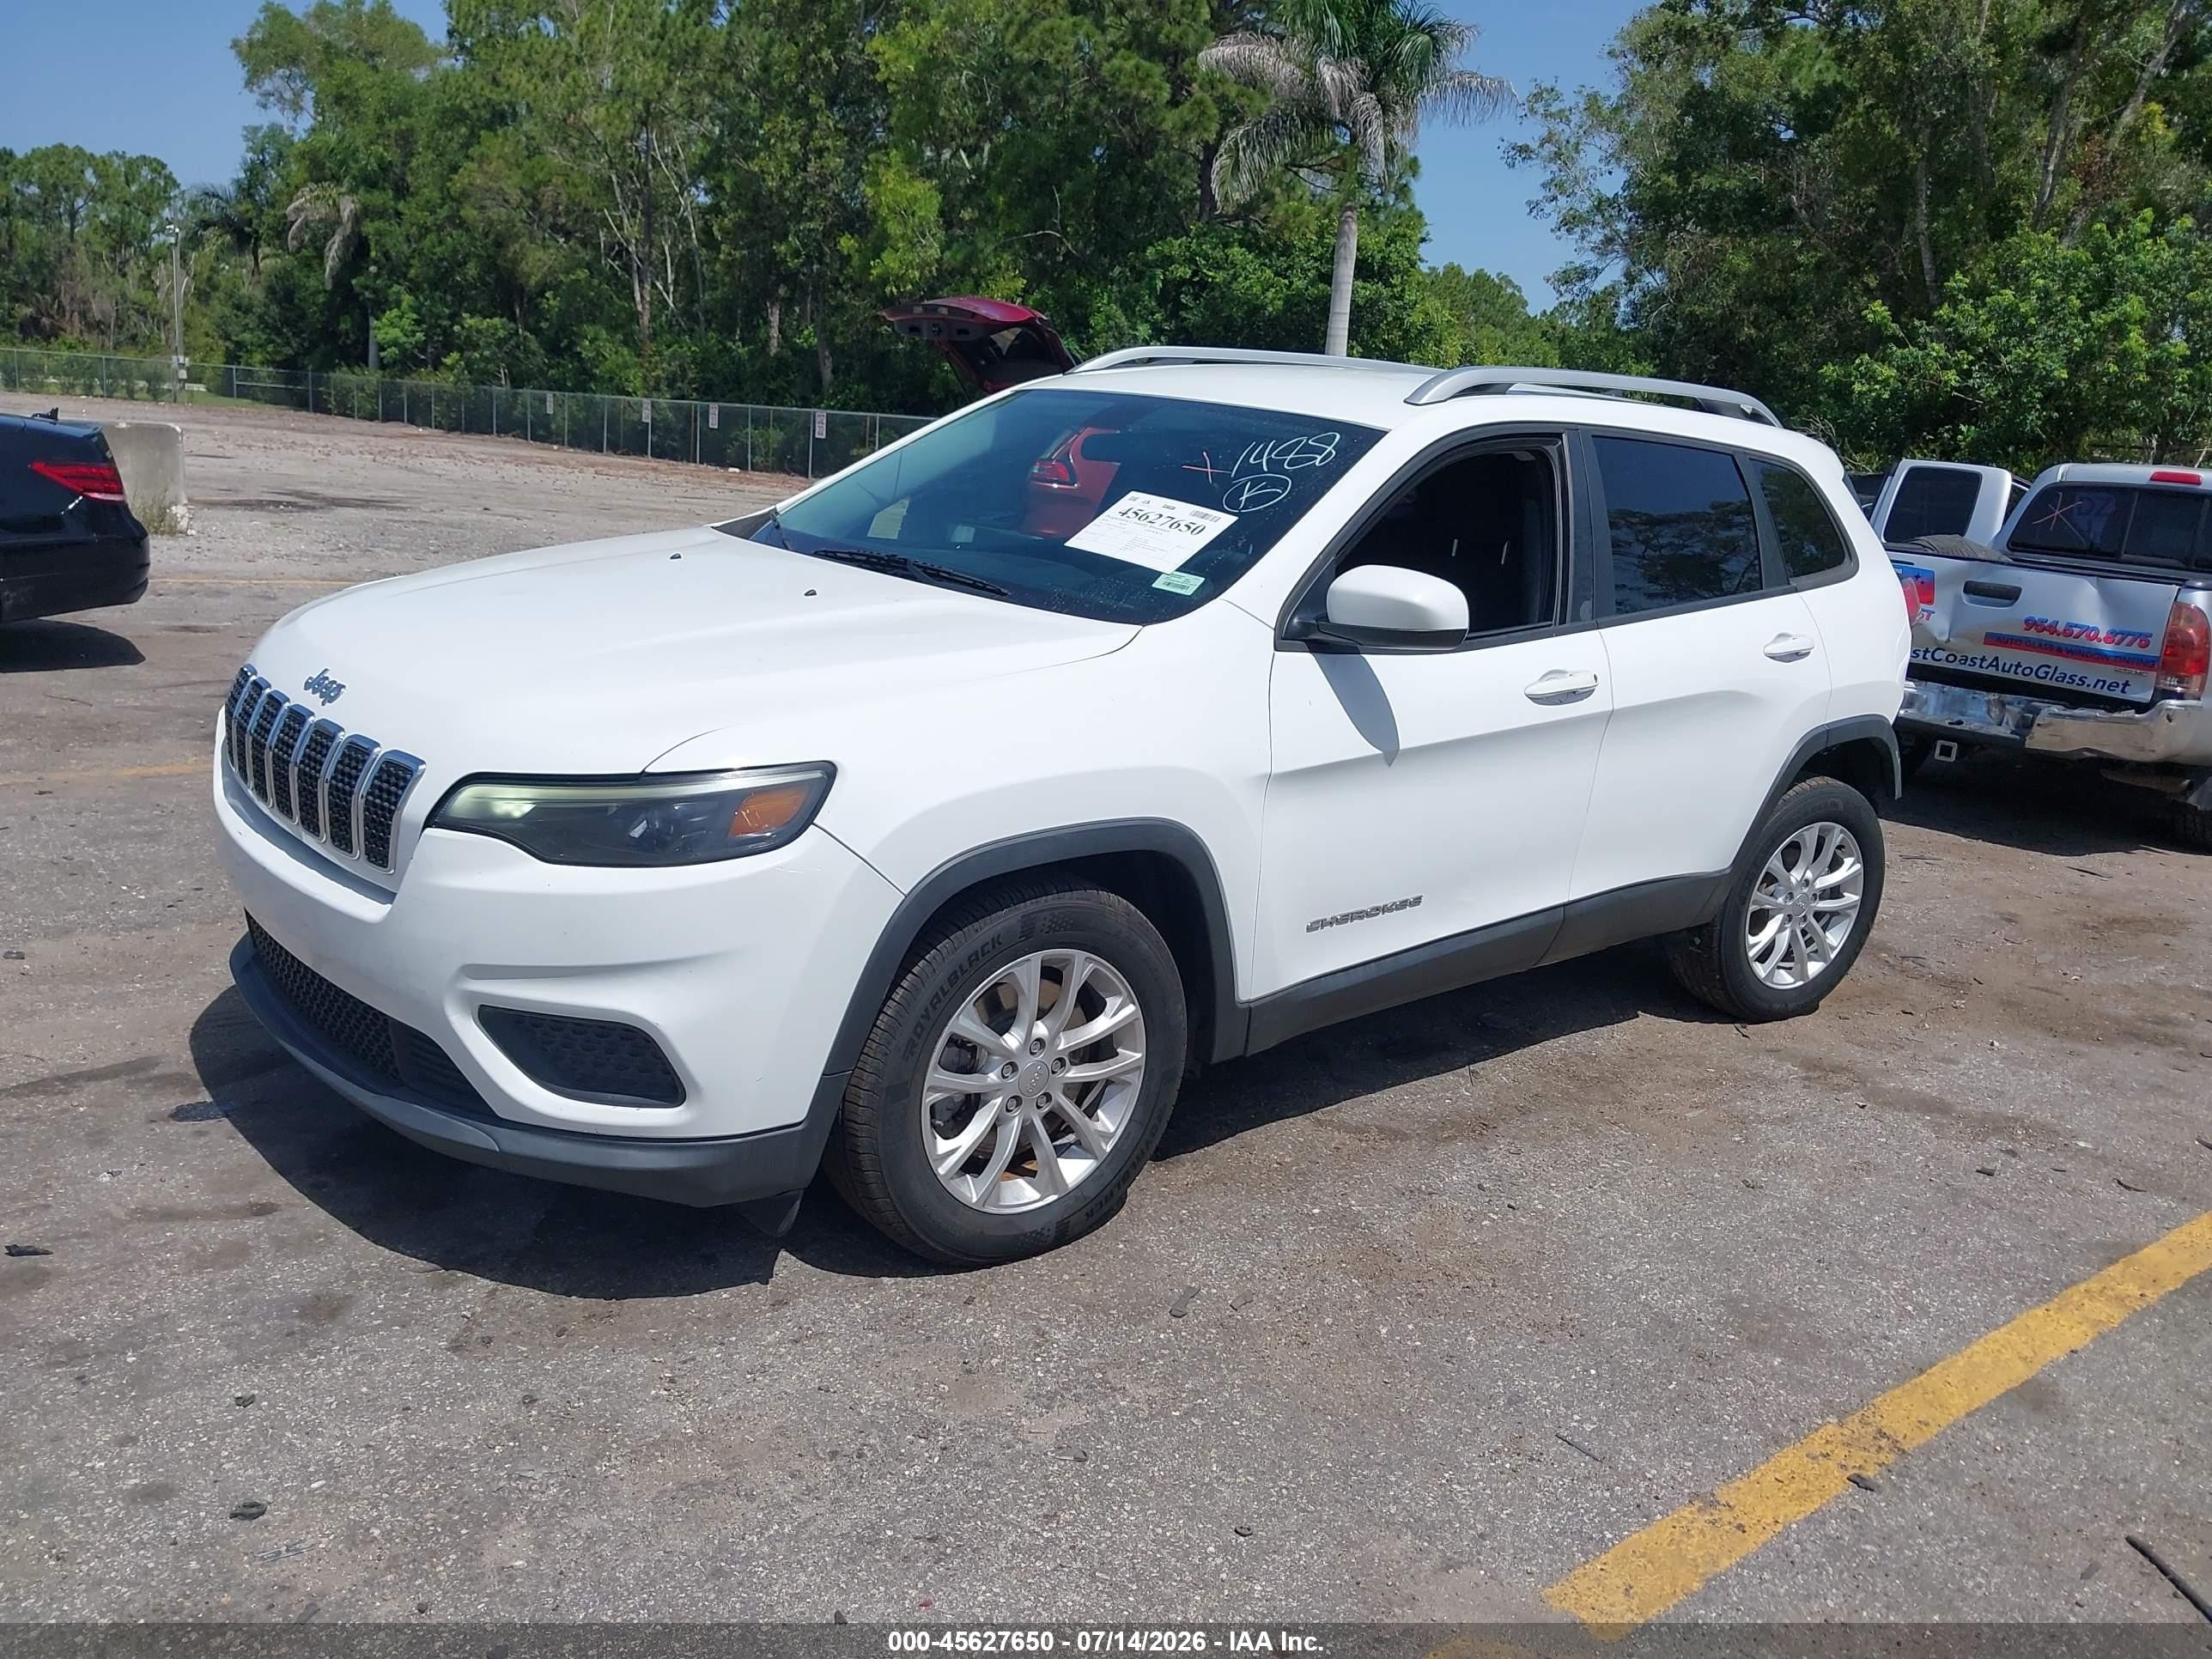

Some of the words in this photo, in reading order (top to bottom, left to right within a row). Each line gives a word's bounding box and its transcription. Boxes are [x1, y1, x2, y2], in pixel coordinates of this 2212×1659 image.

[1118, 507, 1206, 536] 45627650
[1996, 636, 2022, 647] AUTO
[2025, 640, 2055, 651] GLASS
[2065, 647, 2111, 662] WINDOW
[2023, 616, 2153, 648] 954.570.8775
[304, 667, 347, 707] Jeep
[1911, 647, 2131, 694] stCoastAutoGlass.net
[1306, 895, 1424, 933] CHEROKEE
[904, 933, 1003, 1063] ROYALBLACK
